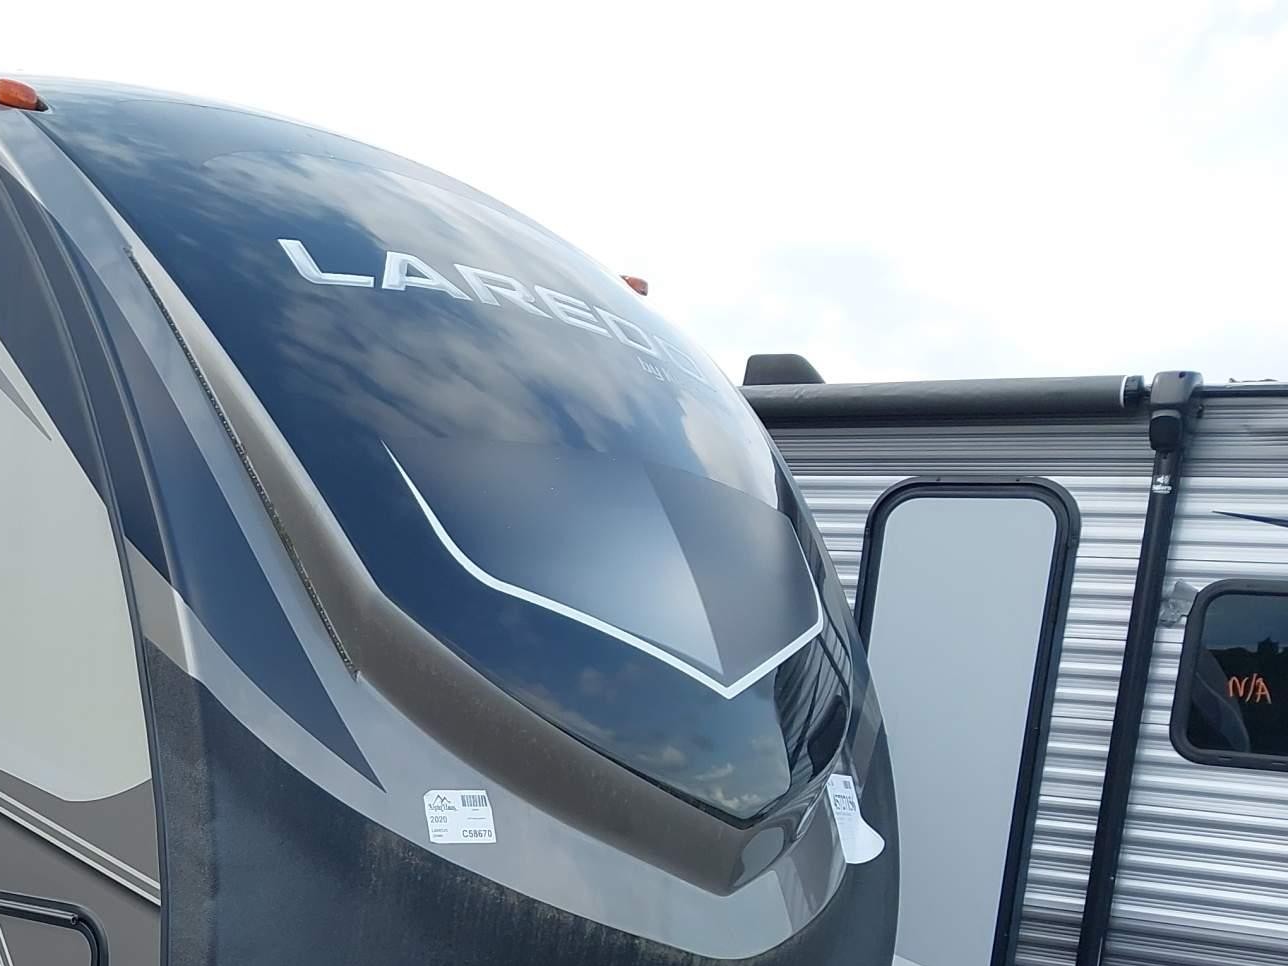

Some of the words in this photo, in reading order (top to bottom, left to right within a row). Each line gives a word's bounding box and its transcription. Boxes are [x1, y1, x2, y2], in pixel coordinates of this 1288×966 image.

[277, 238, 716, 392] LAREDO
[1227, 673, 1272, 704] N/A
[430, 815, 448, 824] 2020
